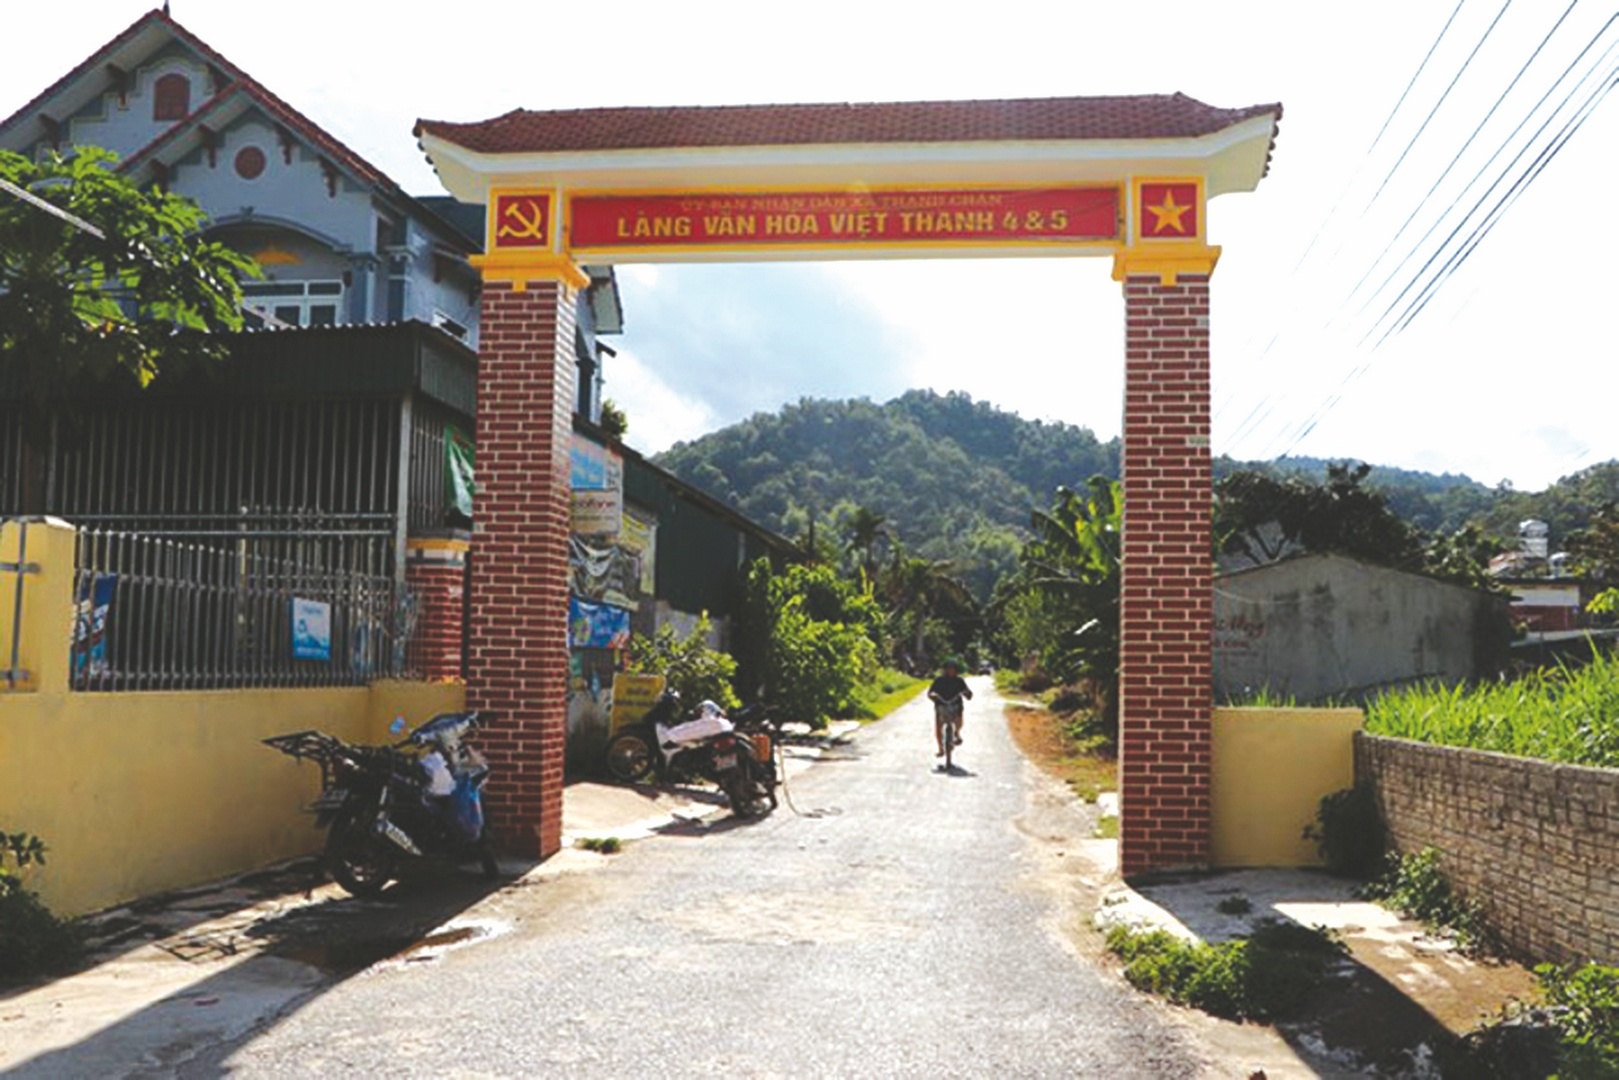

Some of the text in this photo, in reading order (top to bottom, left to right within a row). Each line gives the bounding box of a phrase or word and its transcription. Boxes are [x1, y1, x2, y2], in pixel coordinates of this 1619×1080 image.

[702, 208, 757, 236] VĂN
[829, 210, 888, 237] VIỆT
[900, 210, 994, 233] THANH
